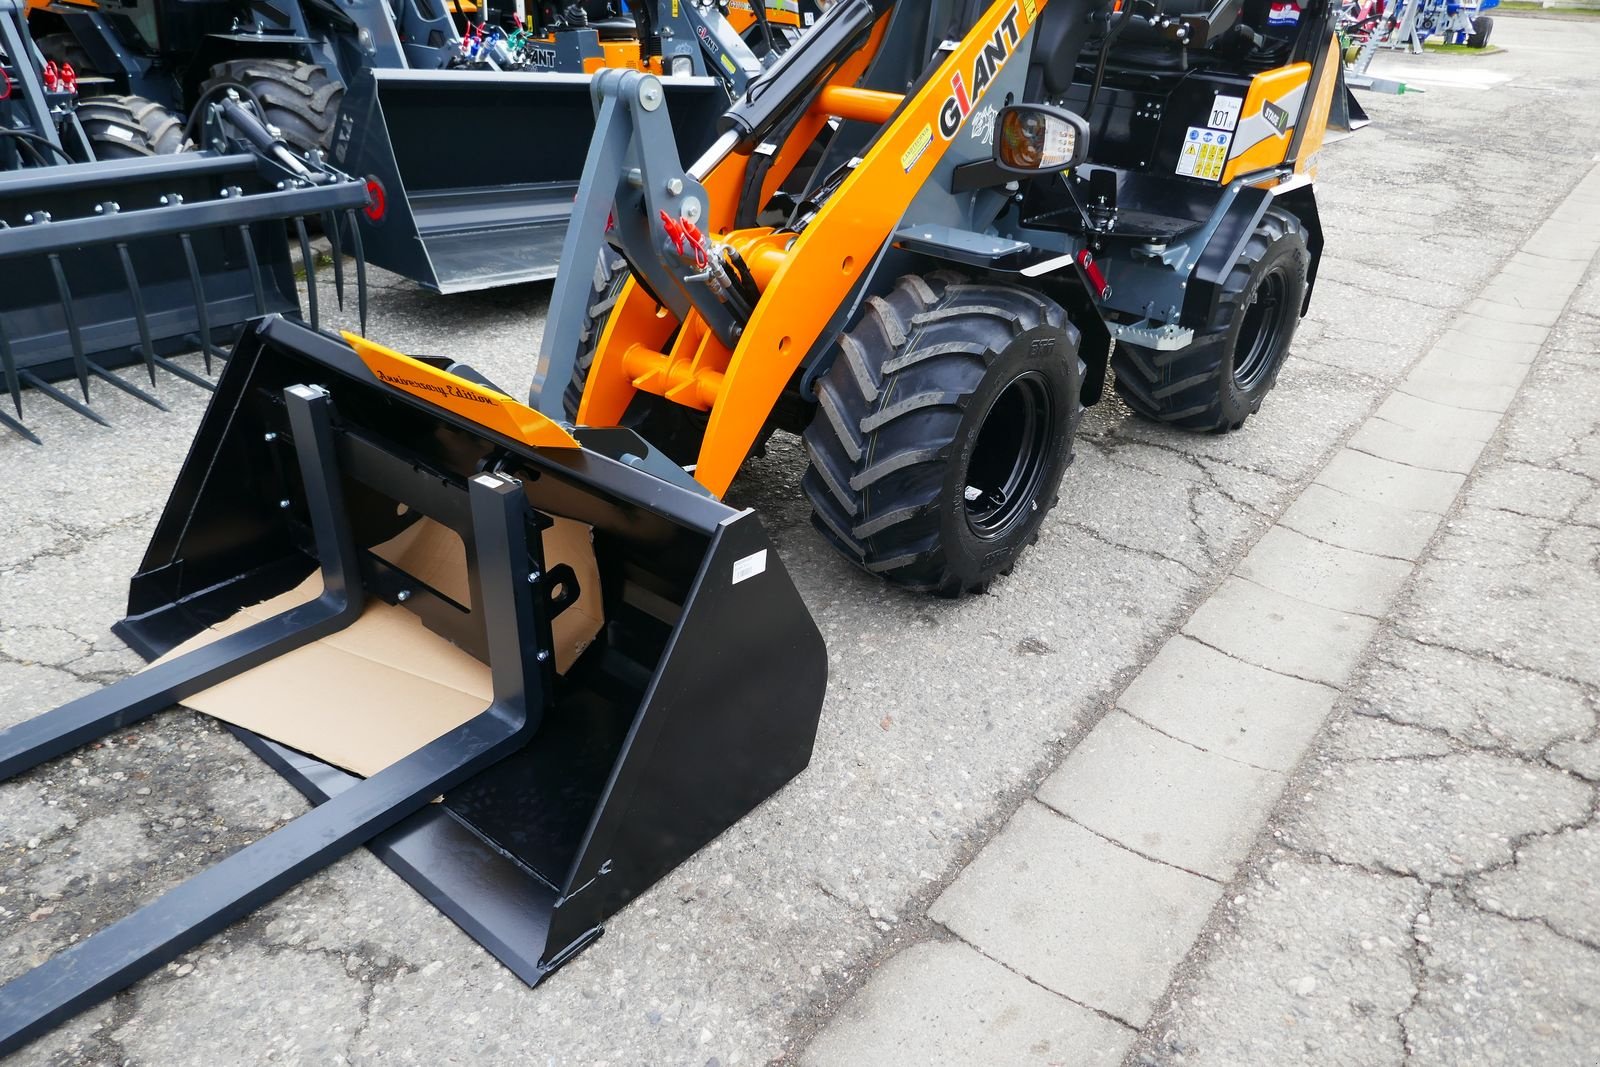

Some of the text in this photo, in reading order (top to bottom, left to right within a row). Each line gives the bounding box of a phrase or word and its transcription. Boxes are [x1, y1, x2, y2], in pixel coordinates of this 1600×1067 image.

[697, 25, 719, 54] GIANT
[938, 0, 1020, 141] GIANT
[1211, 109, 1230, 127] 101
[376, 370, 499, 406] Anniversary Edition
